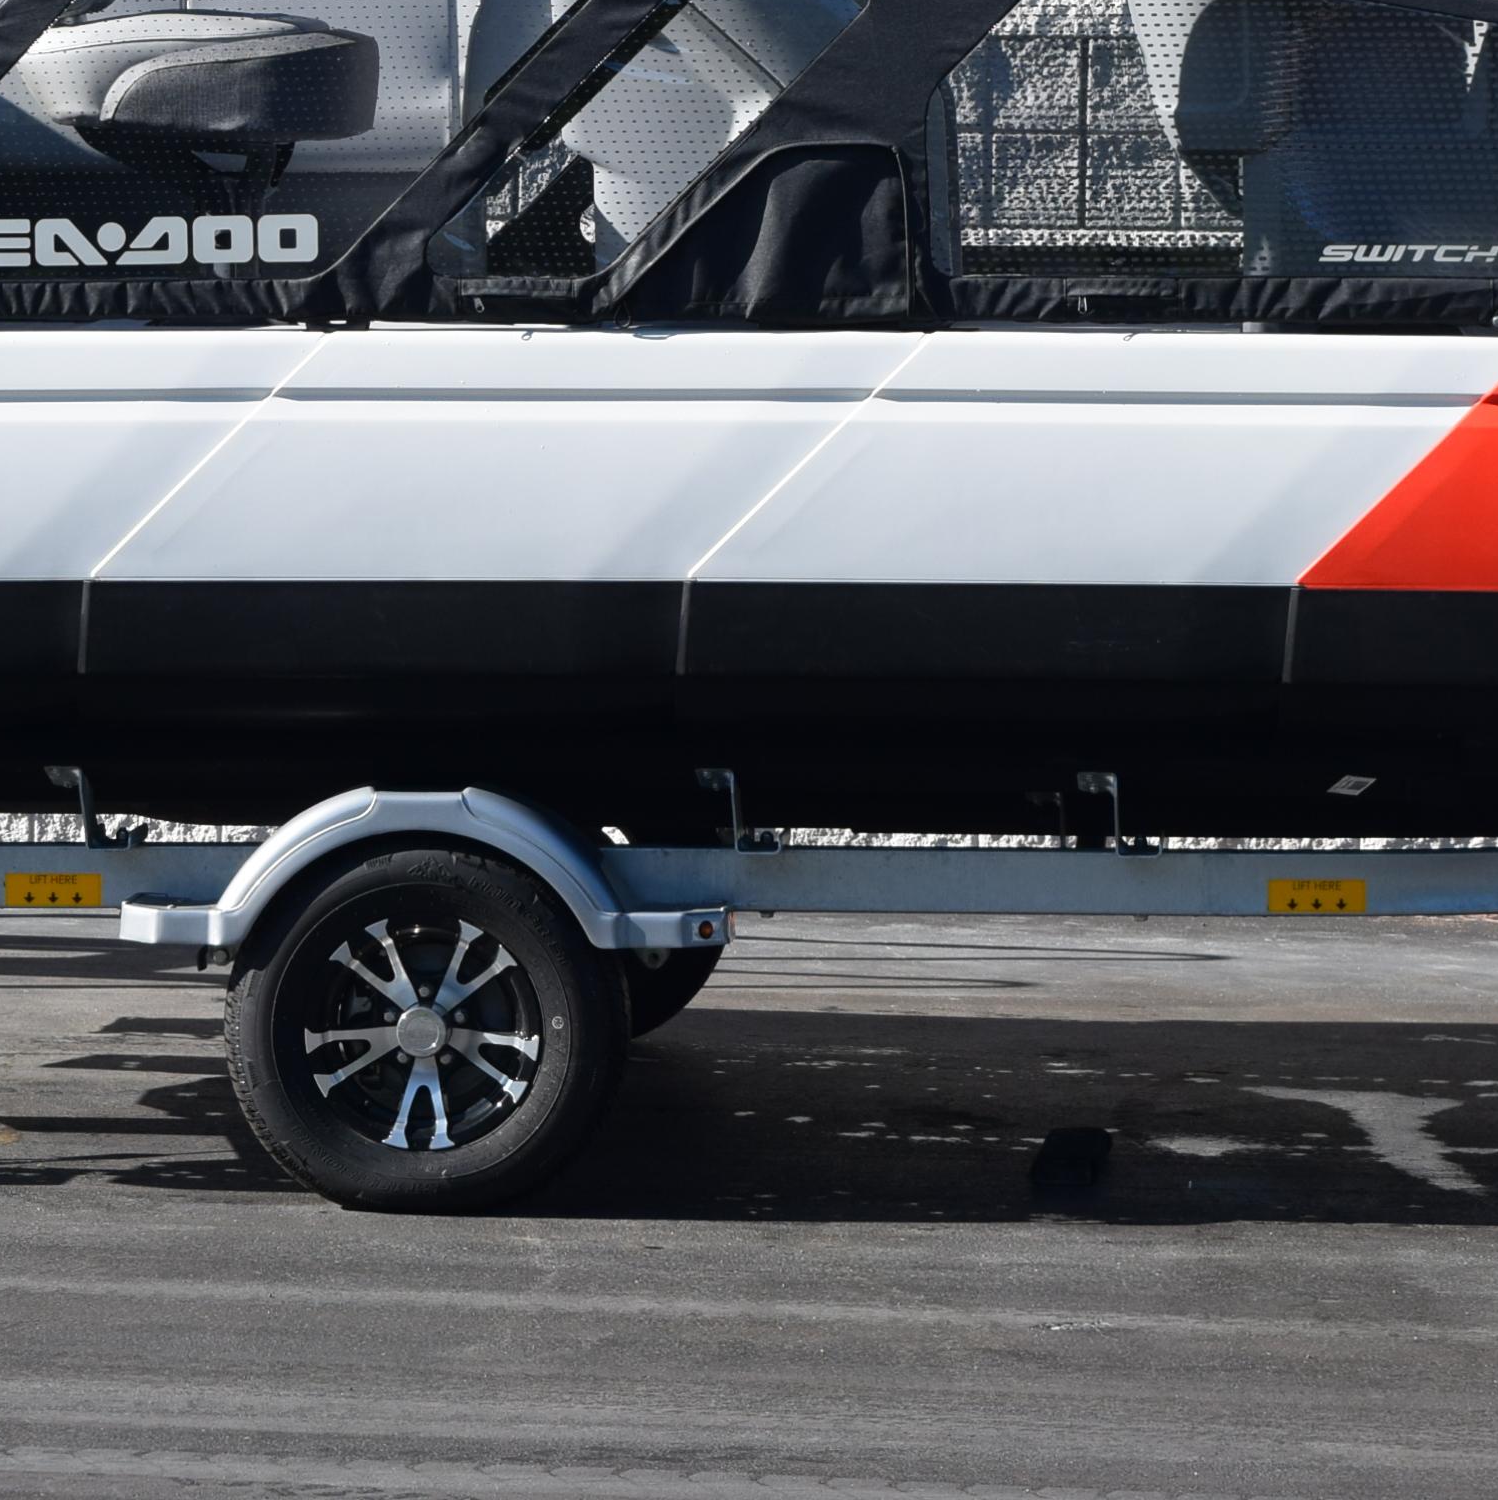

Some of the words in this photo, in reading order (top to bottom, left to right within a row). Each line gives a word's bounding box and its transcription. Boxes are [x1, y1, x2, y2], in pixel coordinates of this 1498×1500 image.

[29, 874, 47, 885] LIFT
[51, 874, 78, 885] HERE
[1292, 880, 1311, 891] LIFT
[1314, 880, 1342, 891] HERE
